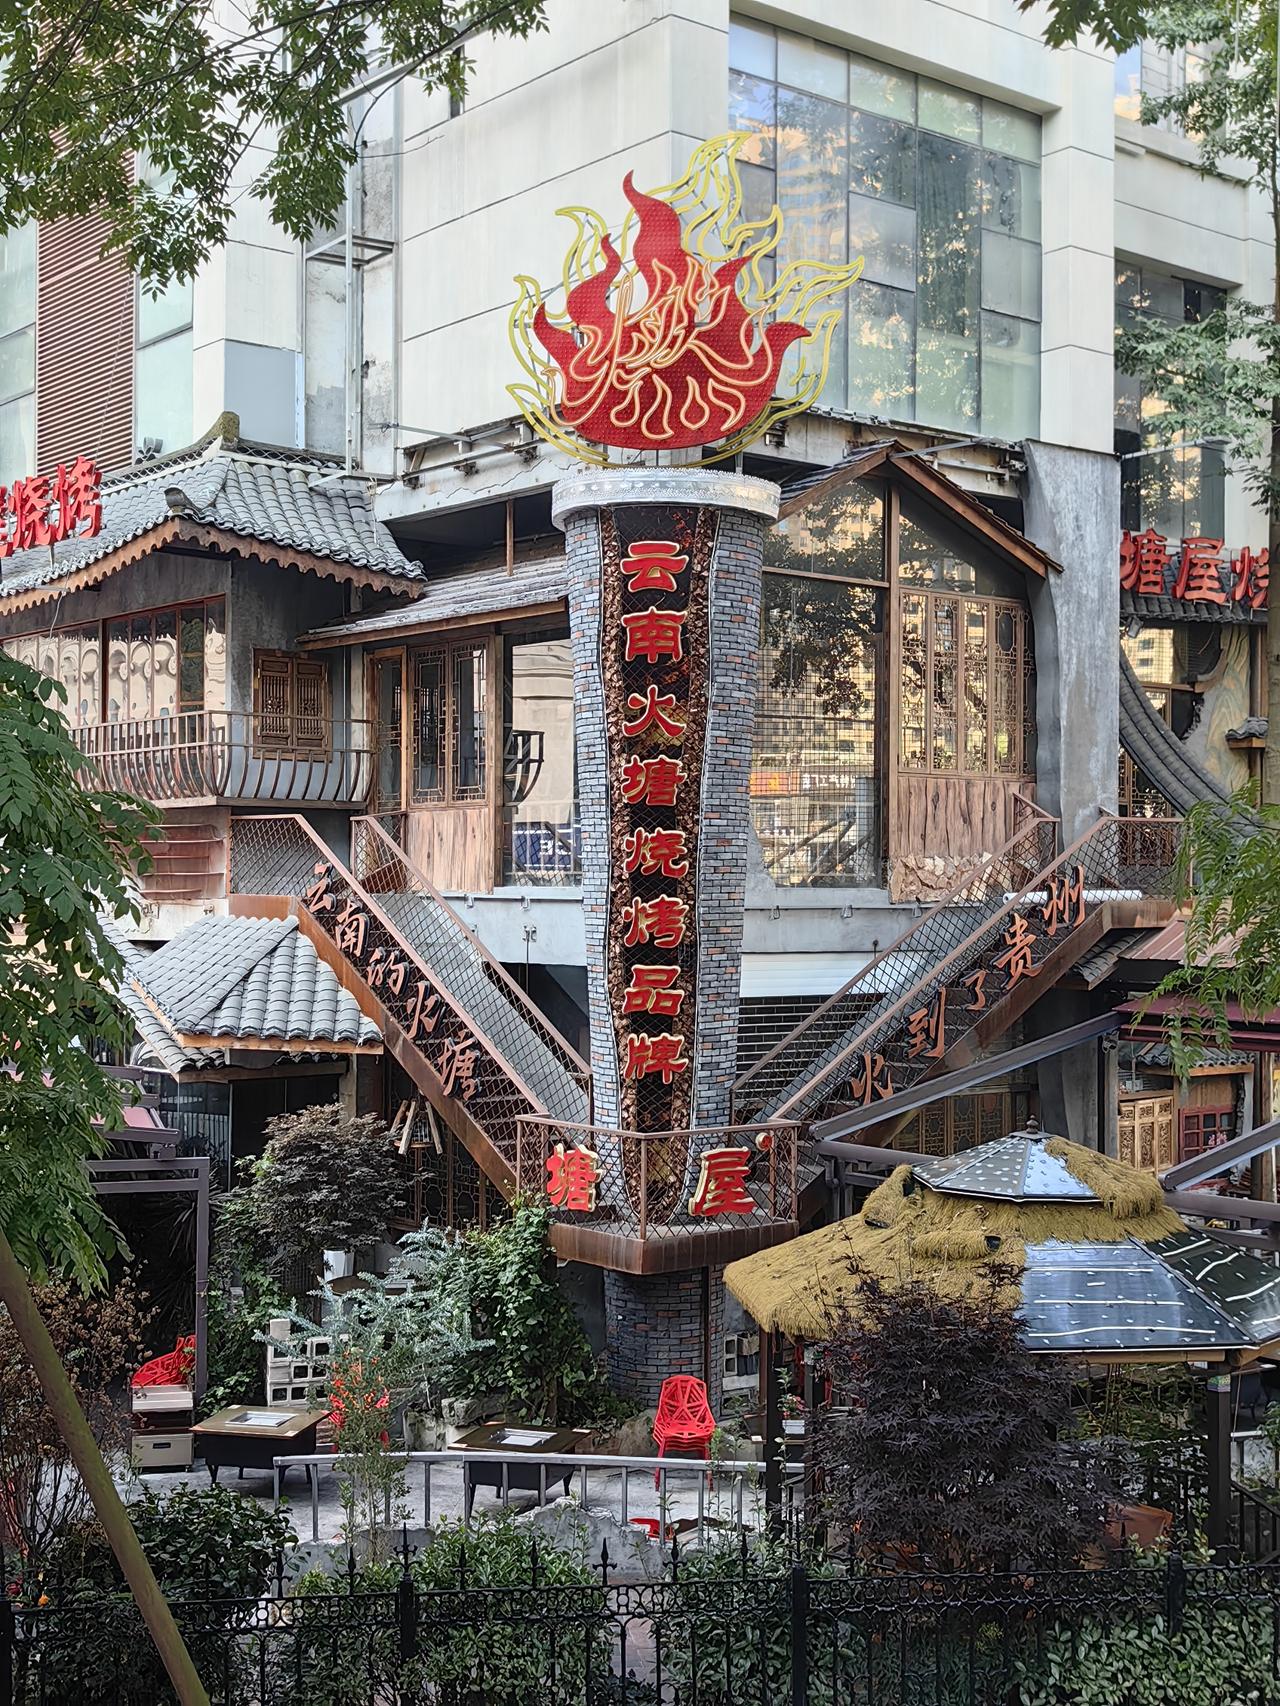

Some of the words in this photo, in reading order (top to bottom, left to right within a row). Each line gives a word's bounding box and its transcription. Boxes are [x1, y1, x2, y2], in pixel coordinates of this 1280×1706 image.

[0, 456, 103, 558] 烧烤
[620, 541, 689, 1084] 云南火塘烧烤品牌
[306, 861, 479, 1100] 云南的火塘
[850, 865, 1086, 1105] 火到了贵州
